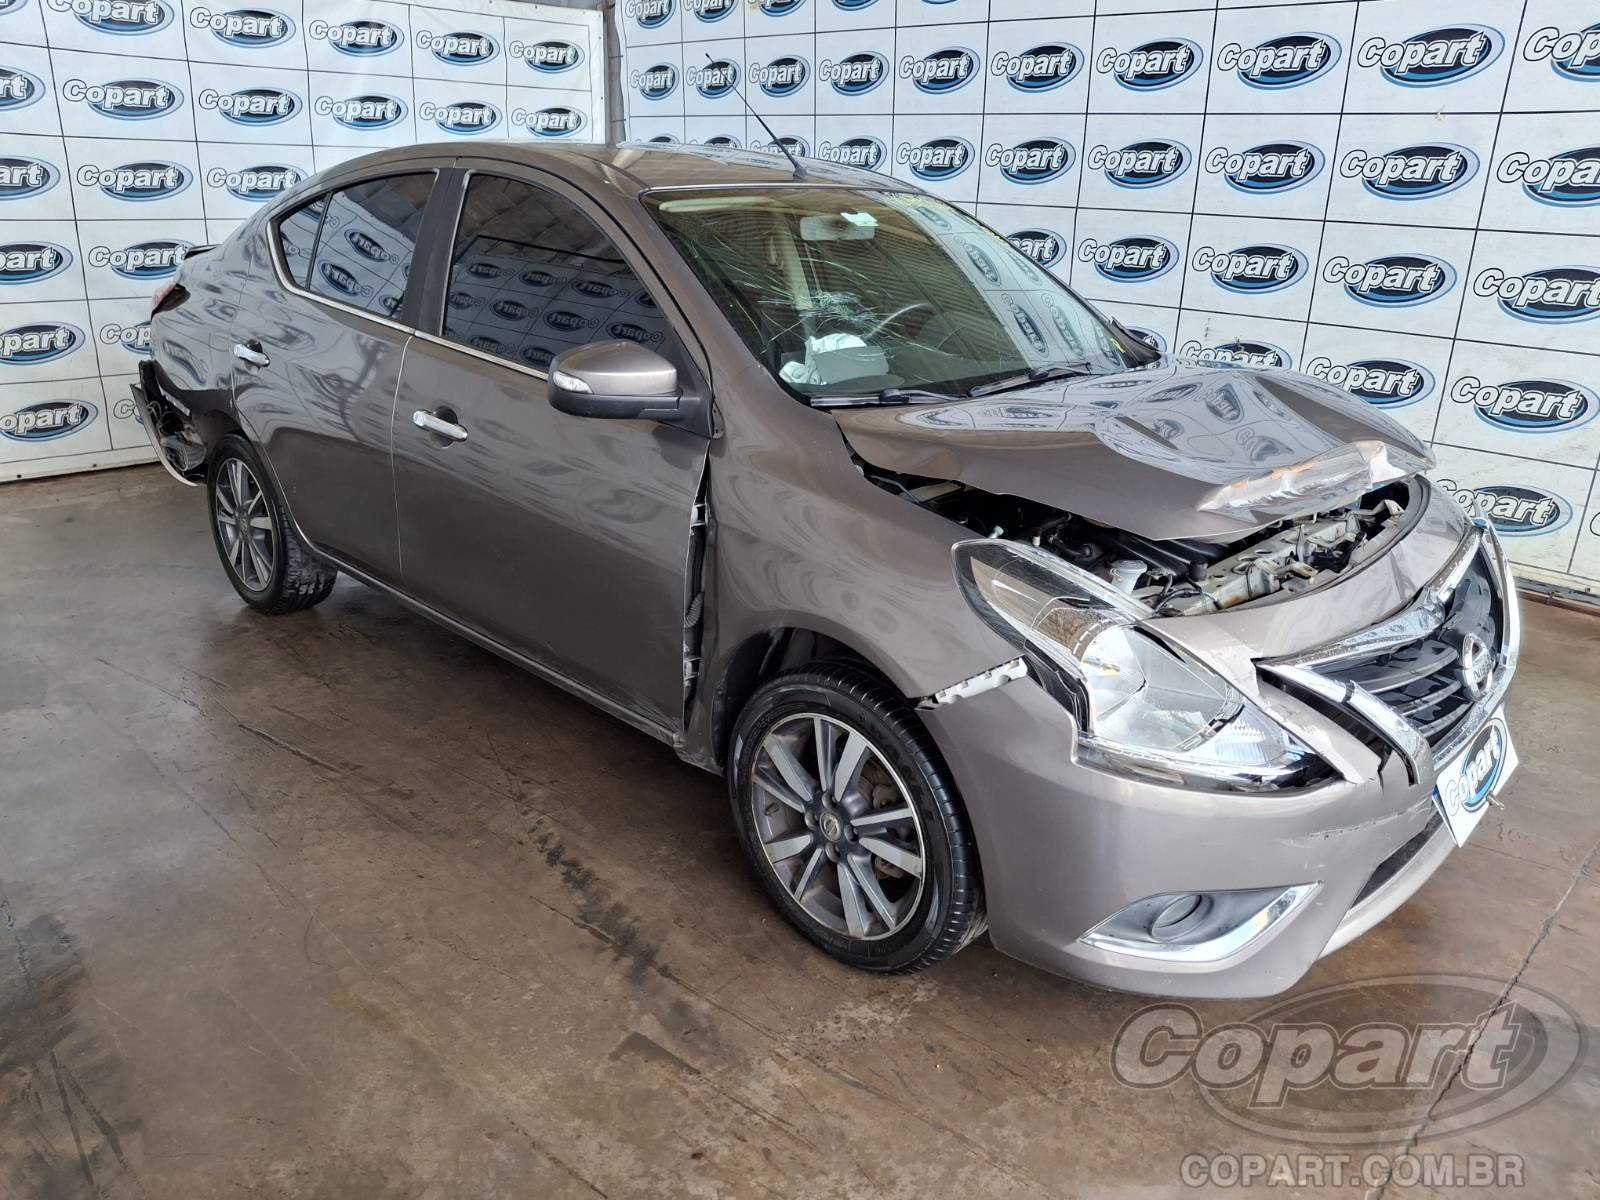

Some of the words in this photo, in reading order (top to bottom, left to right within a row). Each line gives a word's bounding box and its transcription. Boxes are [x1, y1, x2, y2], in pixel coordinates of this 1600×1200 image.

[190, 7, 283, 37] Copart
[309, 20, 392, 47] Copart
[416, 30, 491, 56] Copart
[509, 40, 576, 64] Copart
[1217, 38, 1328, 77] Copart
[1357, 31, 1487, 75] Copart
[1523, 27, 1600, 68] Cop
[686, 61, 736, 90] Copart
[749, 60, 804, 90] Copart
[819, 56, 881, 87] Copart
[899, 52, 971, 84] Copart
[991, 48, 1073, 81] Copart
[1096, 43, 1192, 81] Copart
[630, 65, 674, 91] Copart
[63, 79, 170, 109] Copart
[199, 89, 292, 117] Copart
[315, 96, 399, 123] Copart
[419, 102, 493, 127] Copart
[511, 108, 579, 131] Copart
[818, 140, 879, 166] Copart
[896, 141, 966, 171] Copart
[985, 143, 1066, 173] Copart
[1088, 144, 1179, 178] Copart
[1205, 147, 1312, 182] Copart
[1339, 149, 1463, 186] Copart
[0, 162, 43, 187] art
[77, 164, 179, 193] Copart
[207, 168, 296, 194] Copart
[1496, 152, 1600, 192] Copa
[0, 246, 57, 271] art
[89, 245, 188, 273] Copart
[1008, 235, 1056, 261] art
[1078, 238, 1168, 271] Copart
[1193, 245, 1295, 281] Copart
[1323, 256, 1442, 293] Copart
[1473, 267, 1600, 308] Copart
[0, 326, 71, 358] part
[100, 323, 151, 347] Cop
[1306, 356, 1421, 396] Copart
[1451, 376, 1583, 419] Copart
[0, 401, 84, 436] opart
[1445, 724, 1501, 817] Copart
